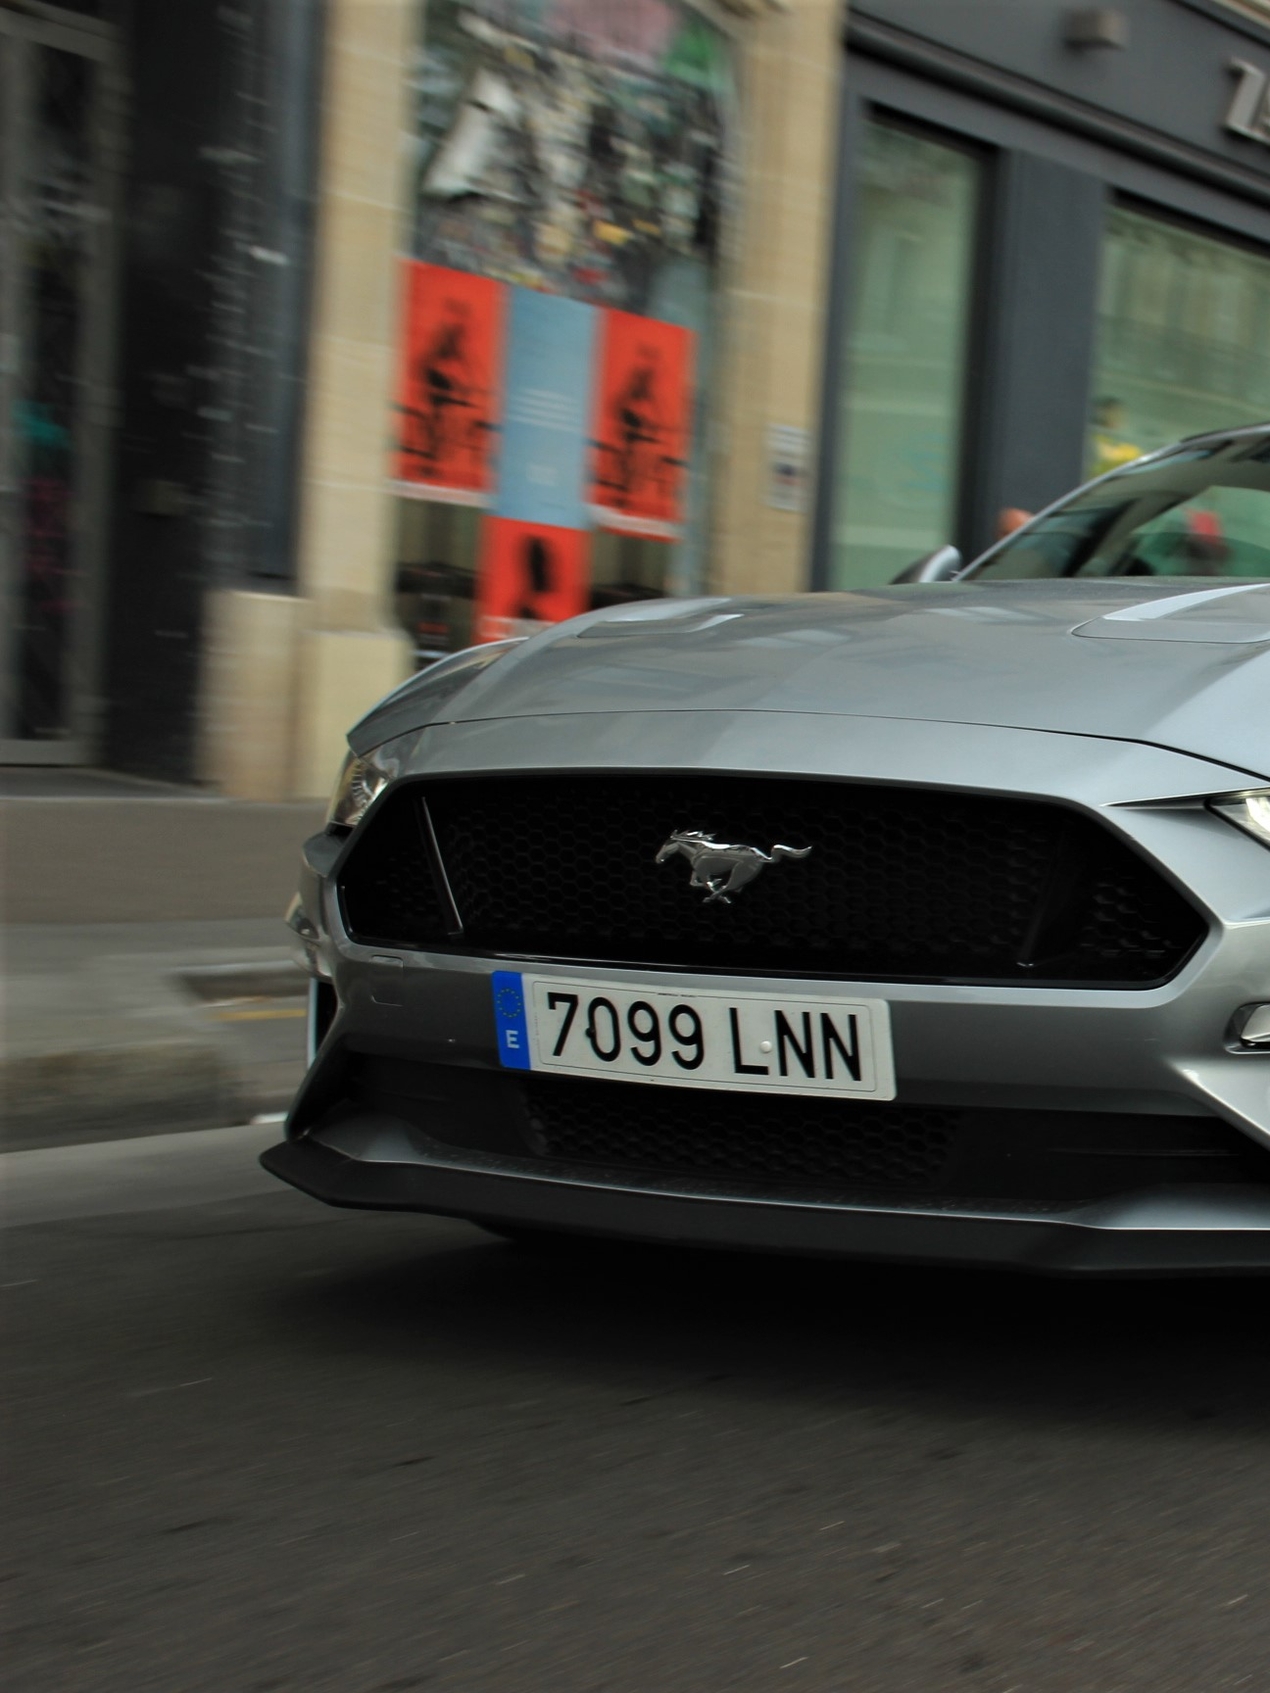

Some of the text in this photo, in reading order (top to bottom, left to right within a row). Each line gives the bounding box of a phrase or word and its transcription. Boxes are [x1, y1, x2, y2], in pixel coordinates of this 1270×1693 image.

[505, 1029, 520, 1049] E
[547, 991, 705, 1071] 7099
[728, 1007, 862, 1082] LNN
